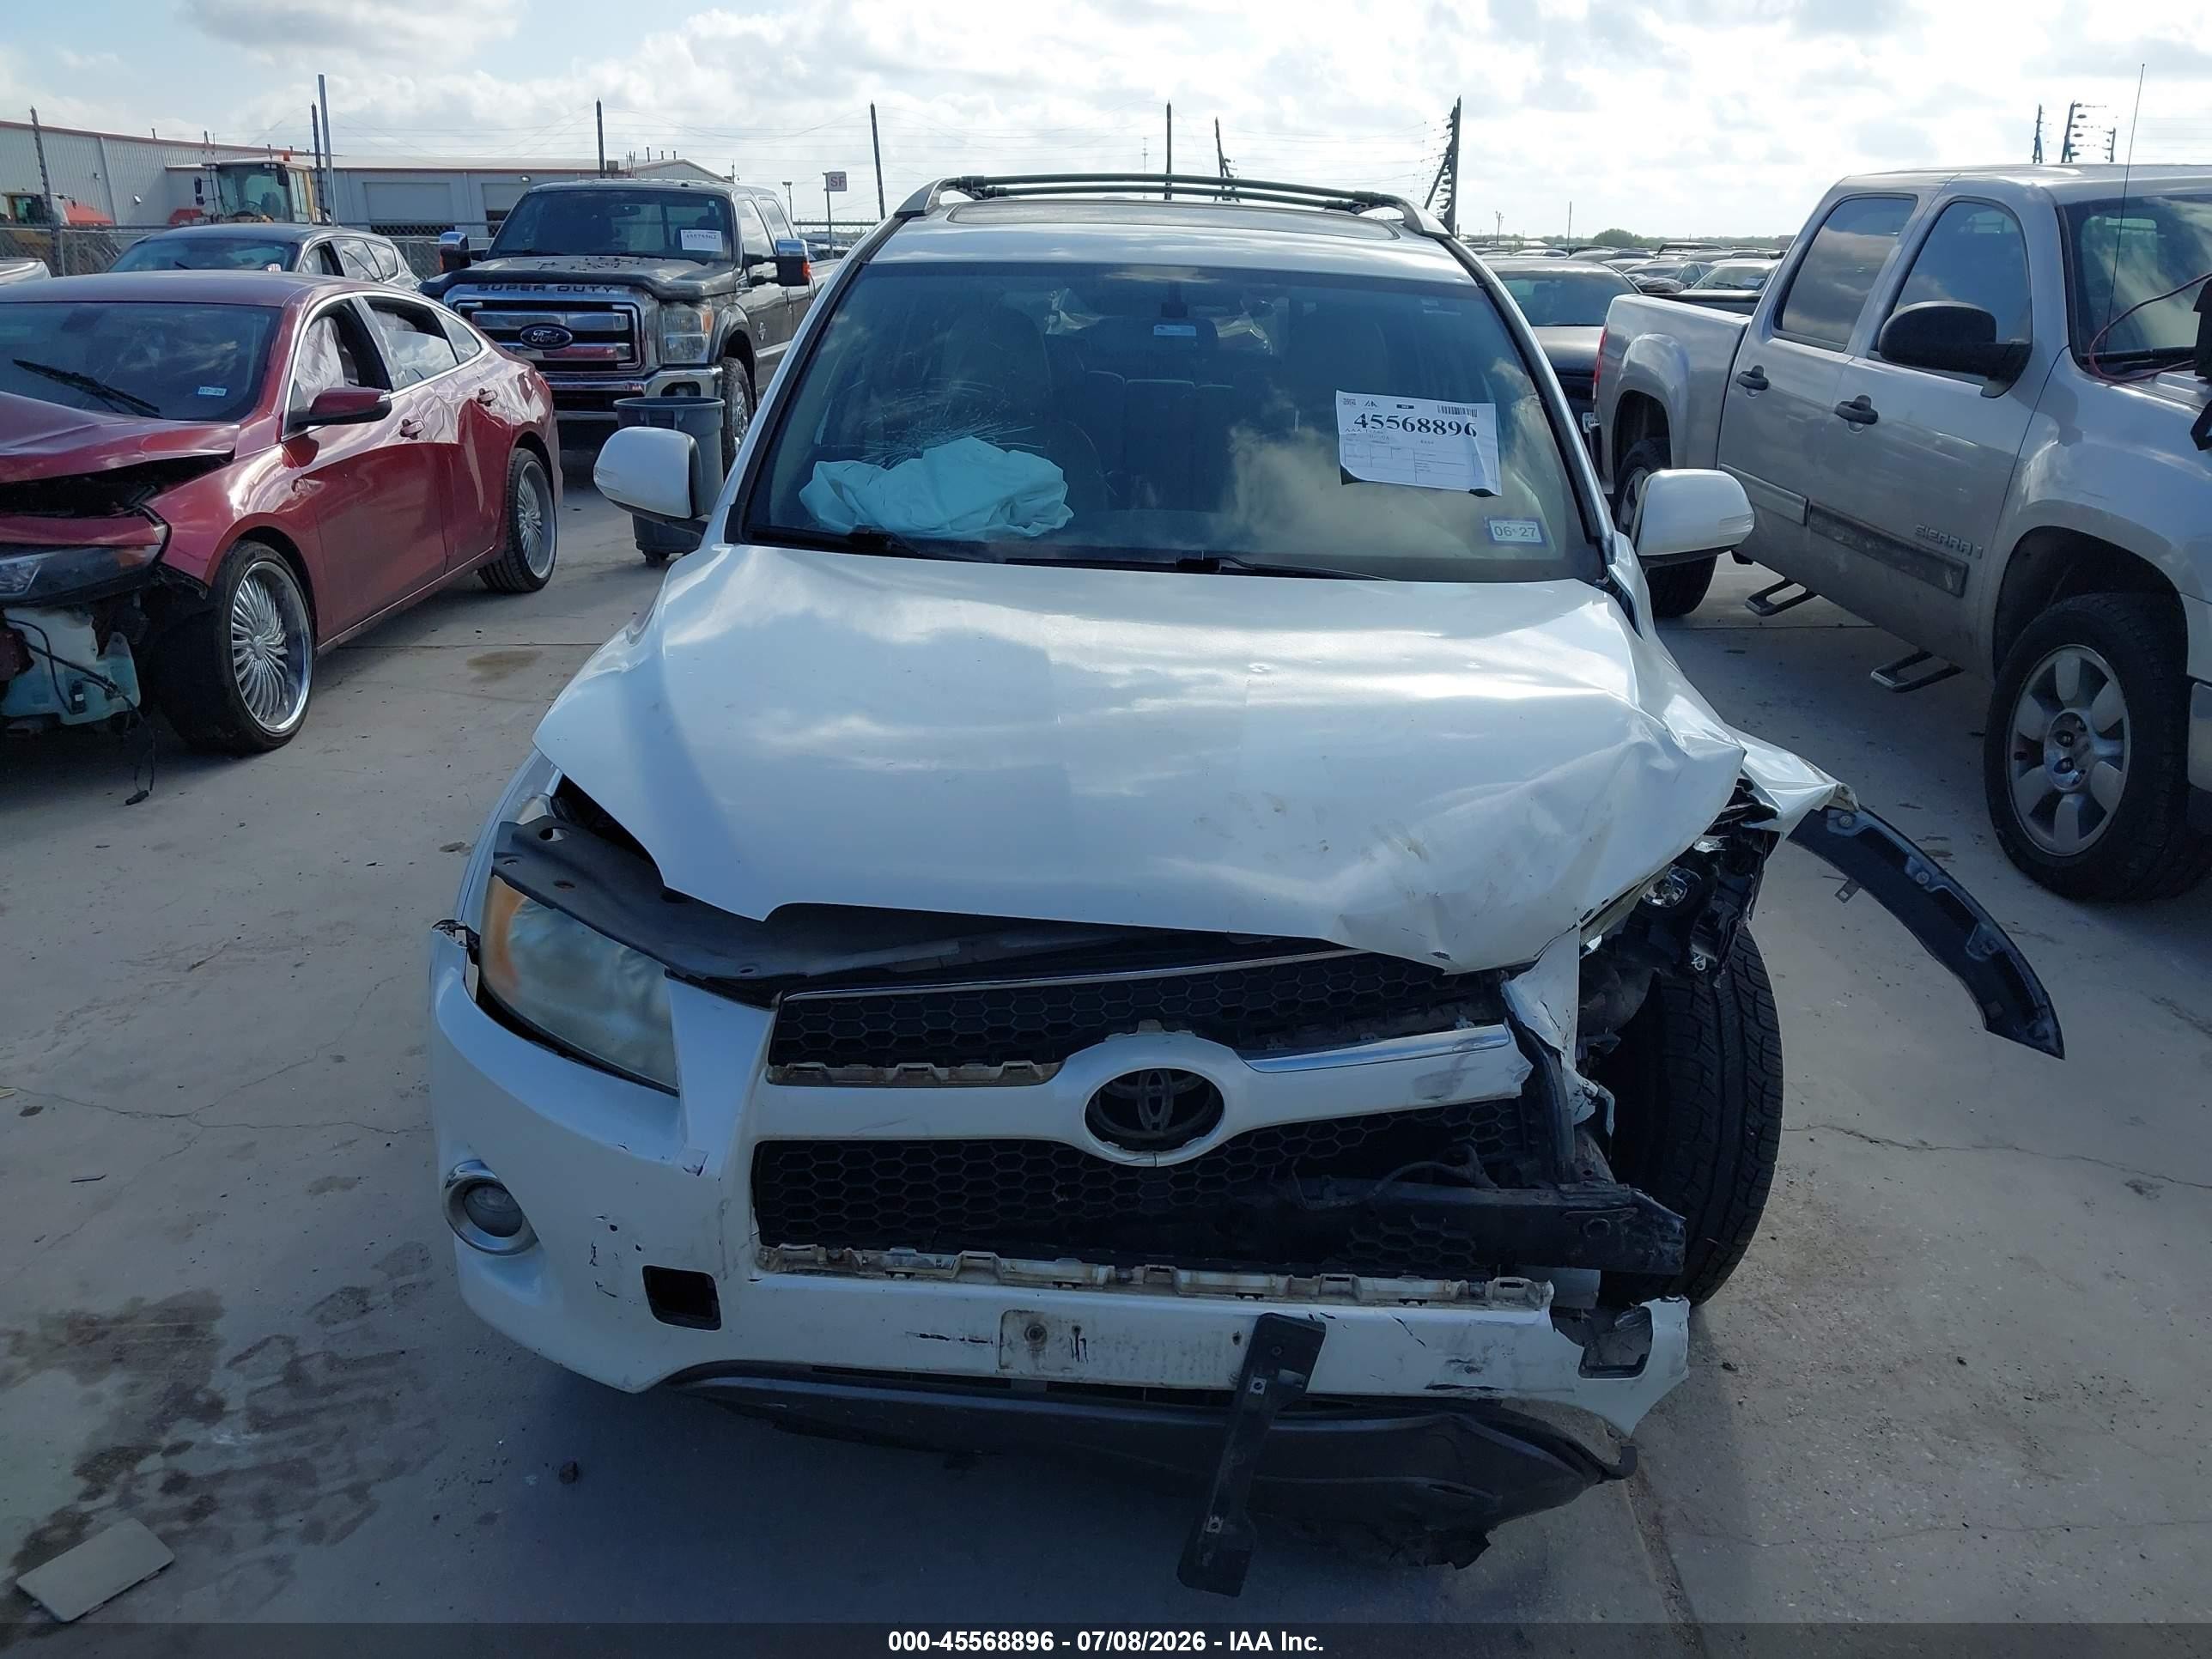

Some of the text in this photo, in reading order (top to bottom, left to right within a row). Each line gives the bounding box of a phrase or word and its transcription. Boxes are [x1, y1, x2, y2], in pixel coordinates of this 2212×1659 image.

[830, 176, 845, 187] SF
[477, 284, 615, 294] SUPER DUTY
[530, 328, 561, 343] Ford
[1353, 413, 1478, 438] 45568896
[1915, 522, 1973, 557] SIERRA
